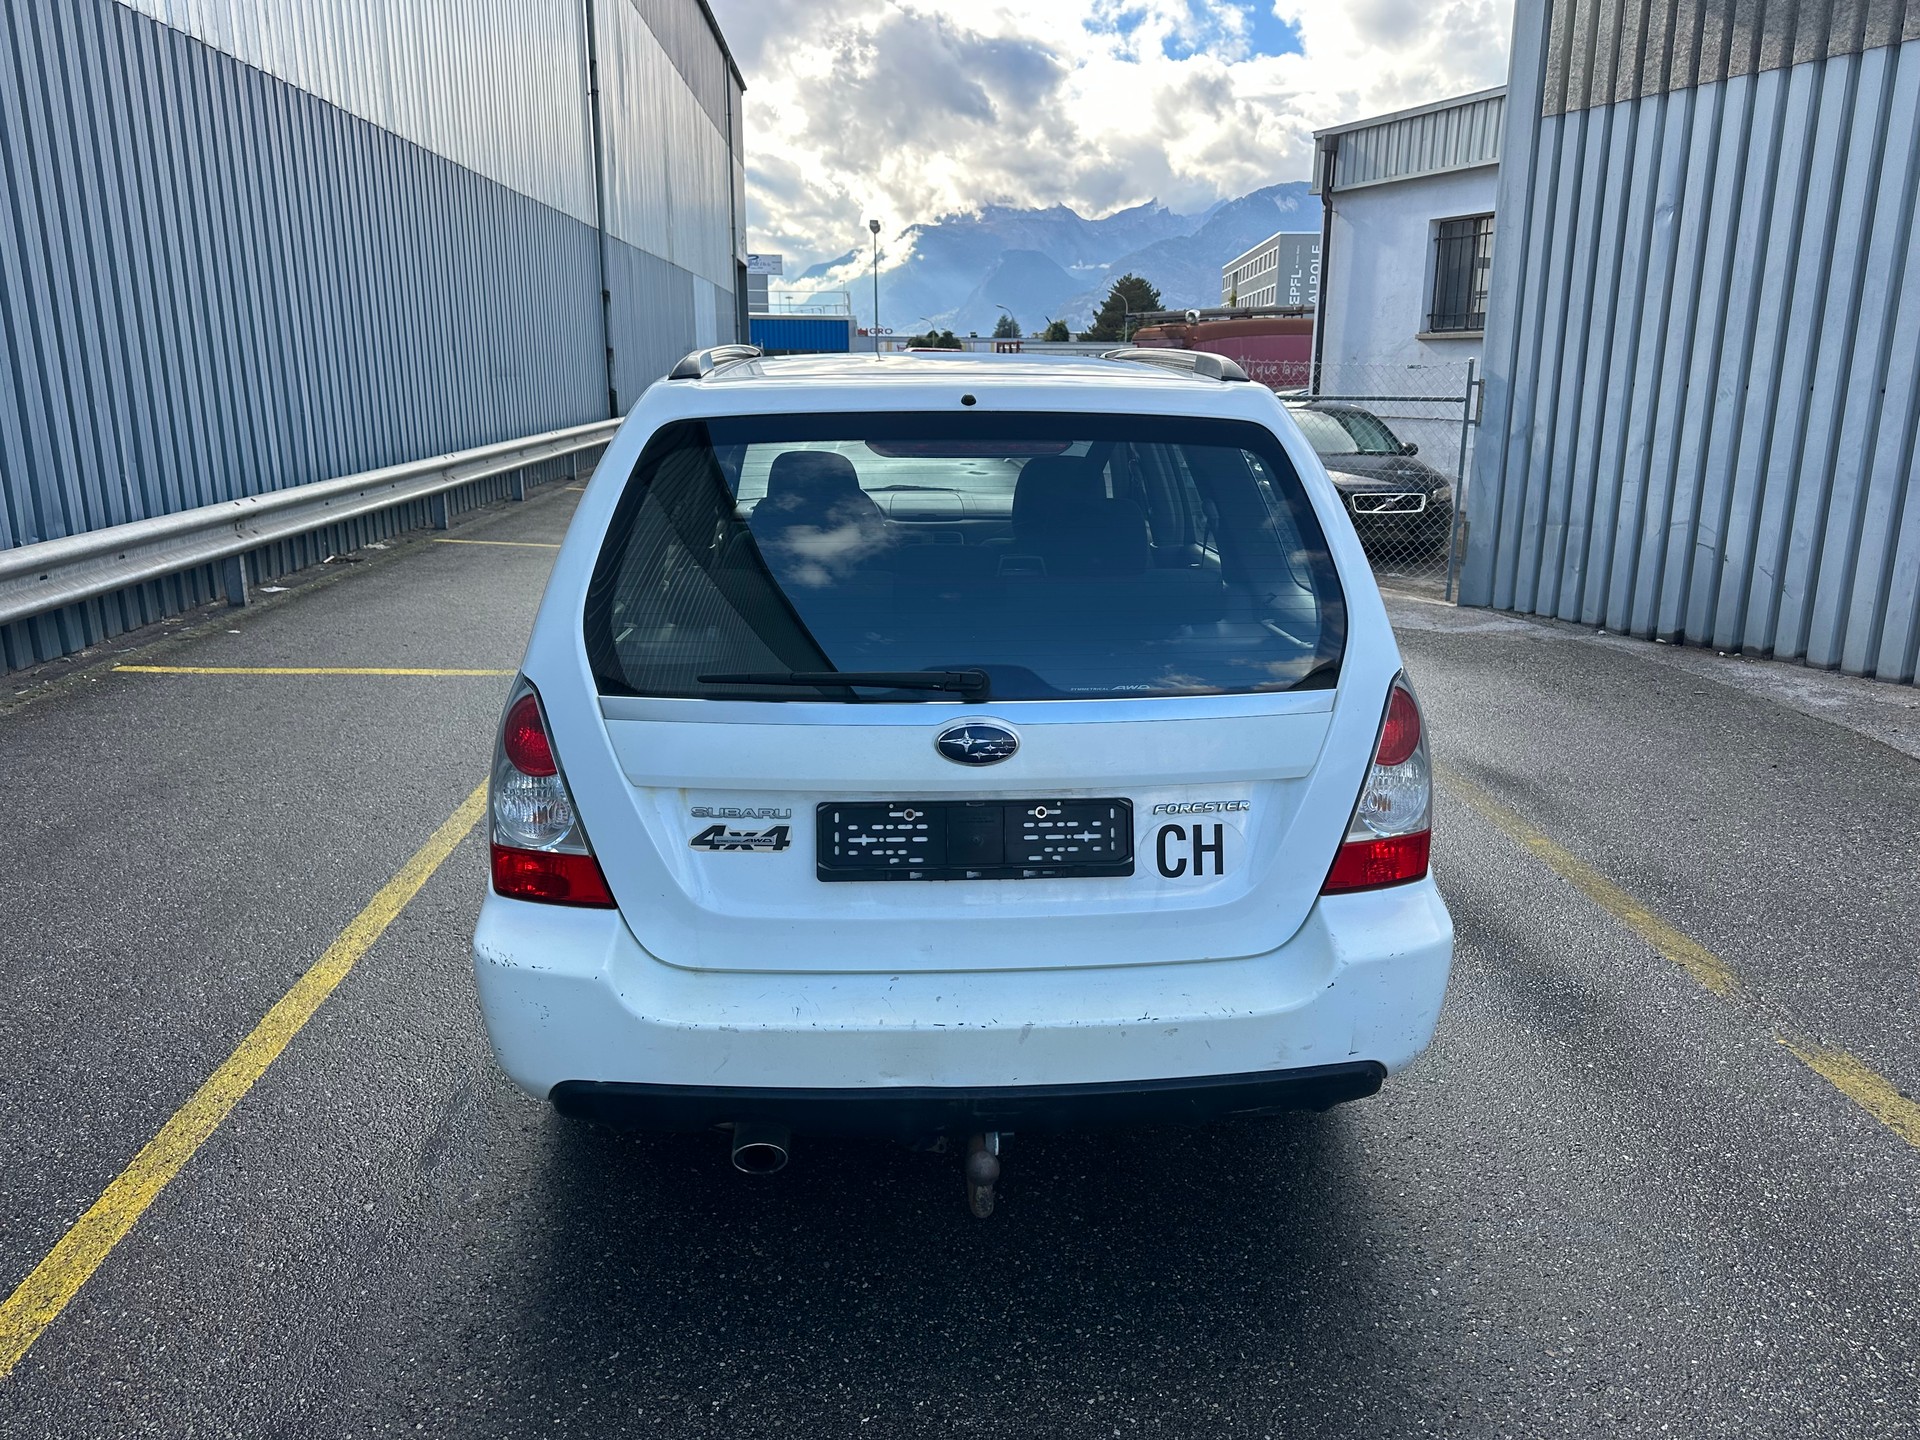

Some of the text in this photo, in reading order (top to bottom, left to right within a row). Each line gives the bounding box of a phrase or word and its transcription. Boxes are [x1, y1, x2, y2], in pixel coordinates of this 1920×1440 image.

[1289, 269, 1302, 305] EPFL
[690, 806, 792, 820] SUBARU
[1152, 800, 1251, 816] FORESTER
[1156, 823, 1224, 879] CH
